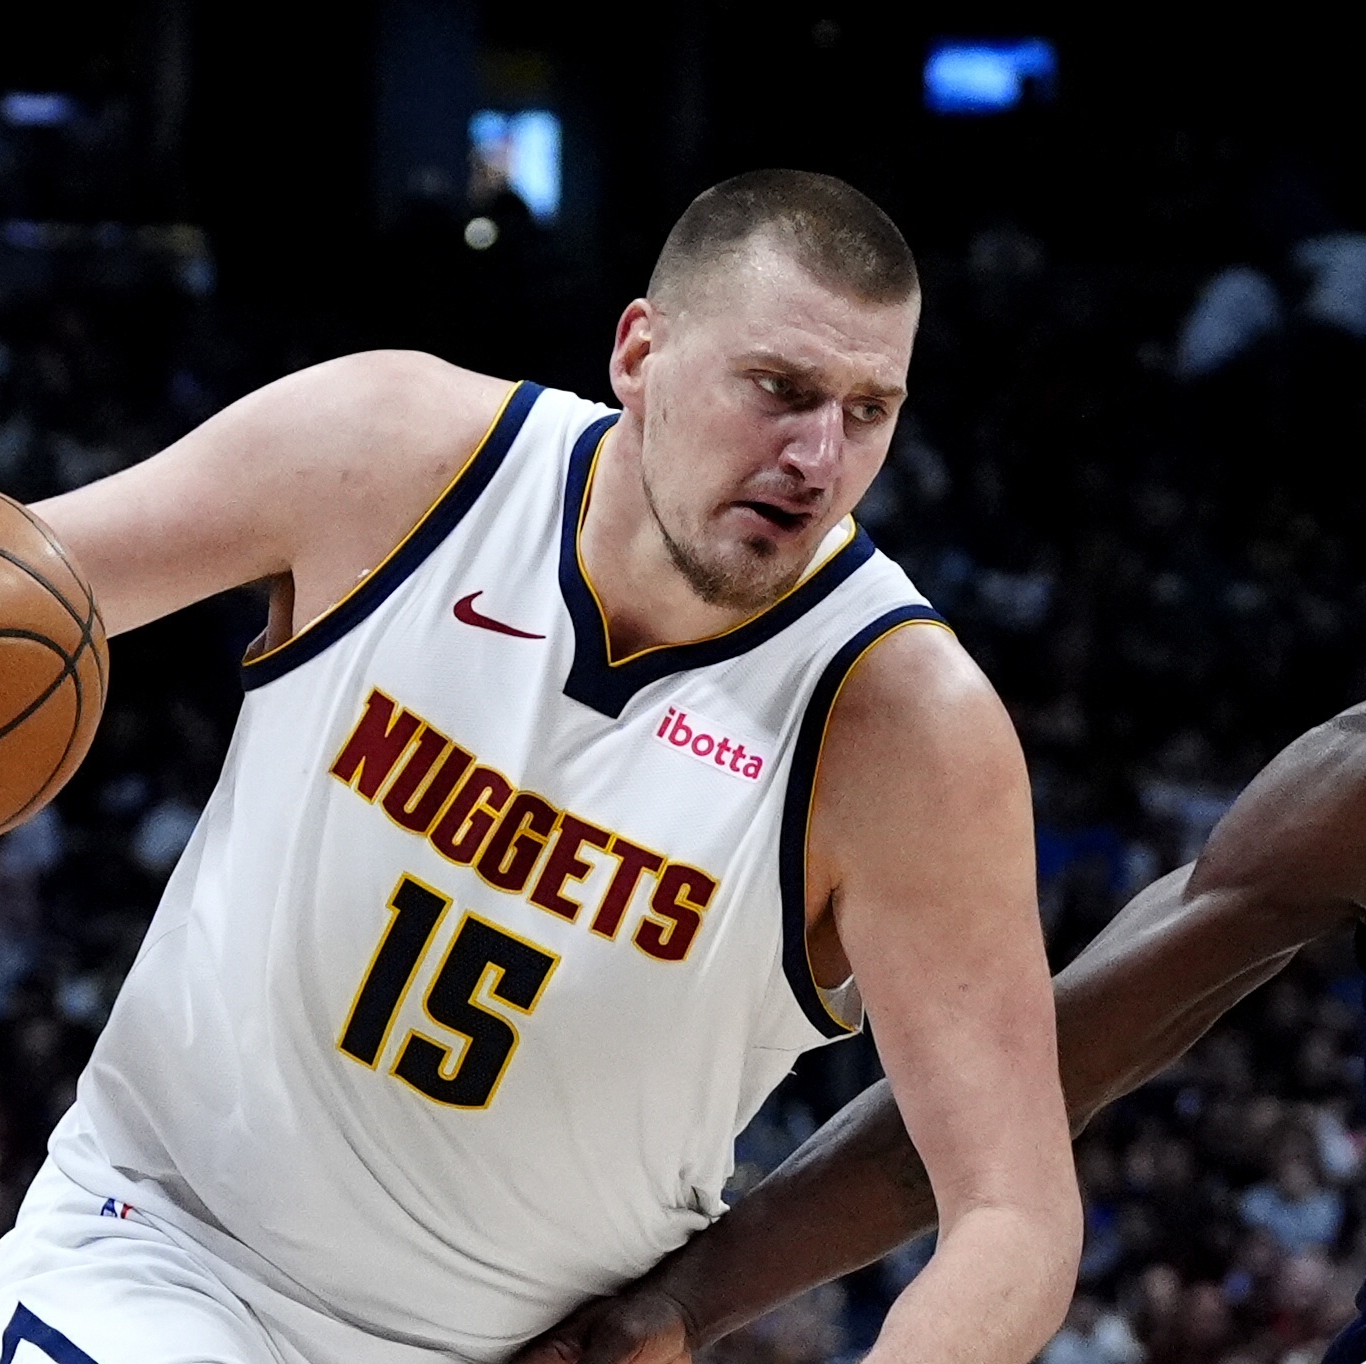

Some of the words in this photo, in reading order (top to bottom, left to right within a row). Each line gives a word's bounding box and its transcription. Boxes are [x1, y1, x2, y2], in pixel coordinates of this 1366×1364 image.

[329, 685, 720, 963] NUGGETS
[656, 706, 764, 781] ibotta
[337, 871, 562, 1110] 15
